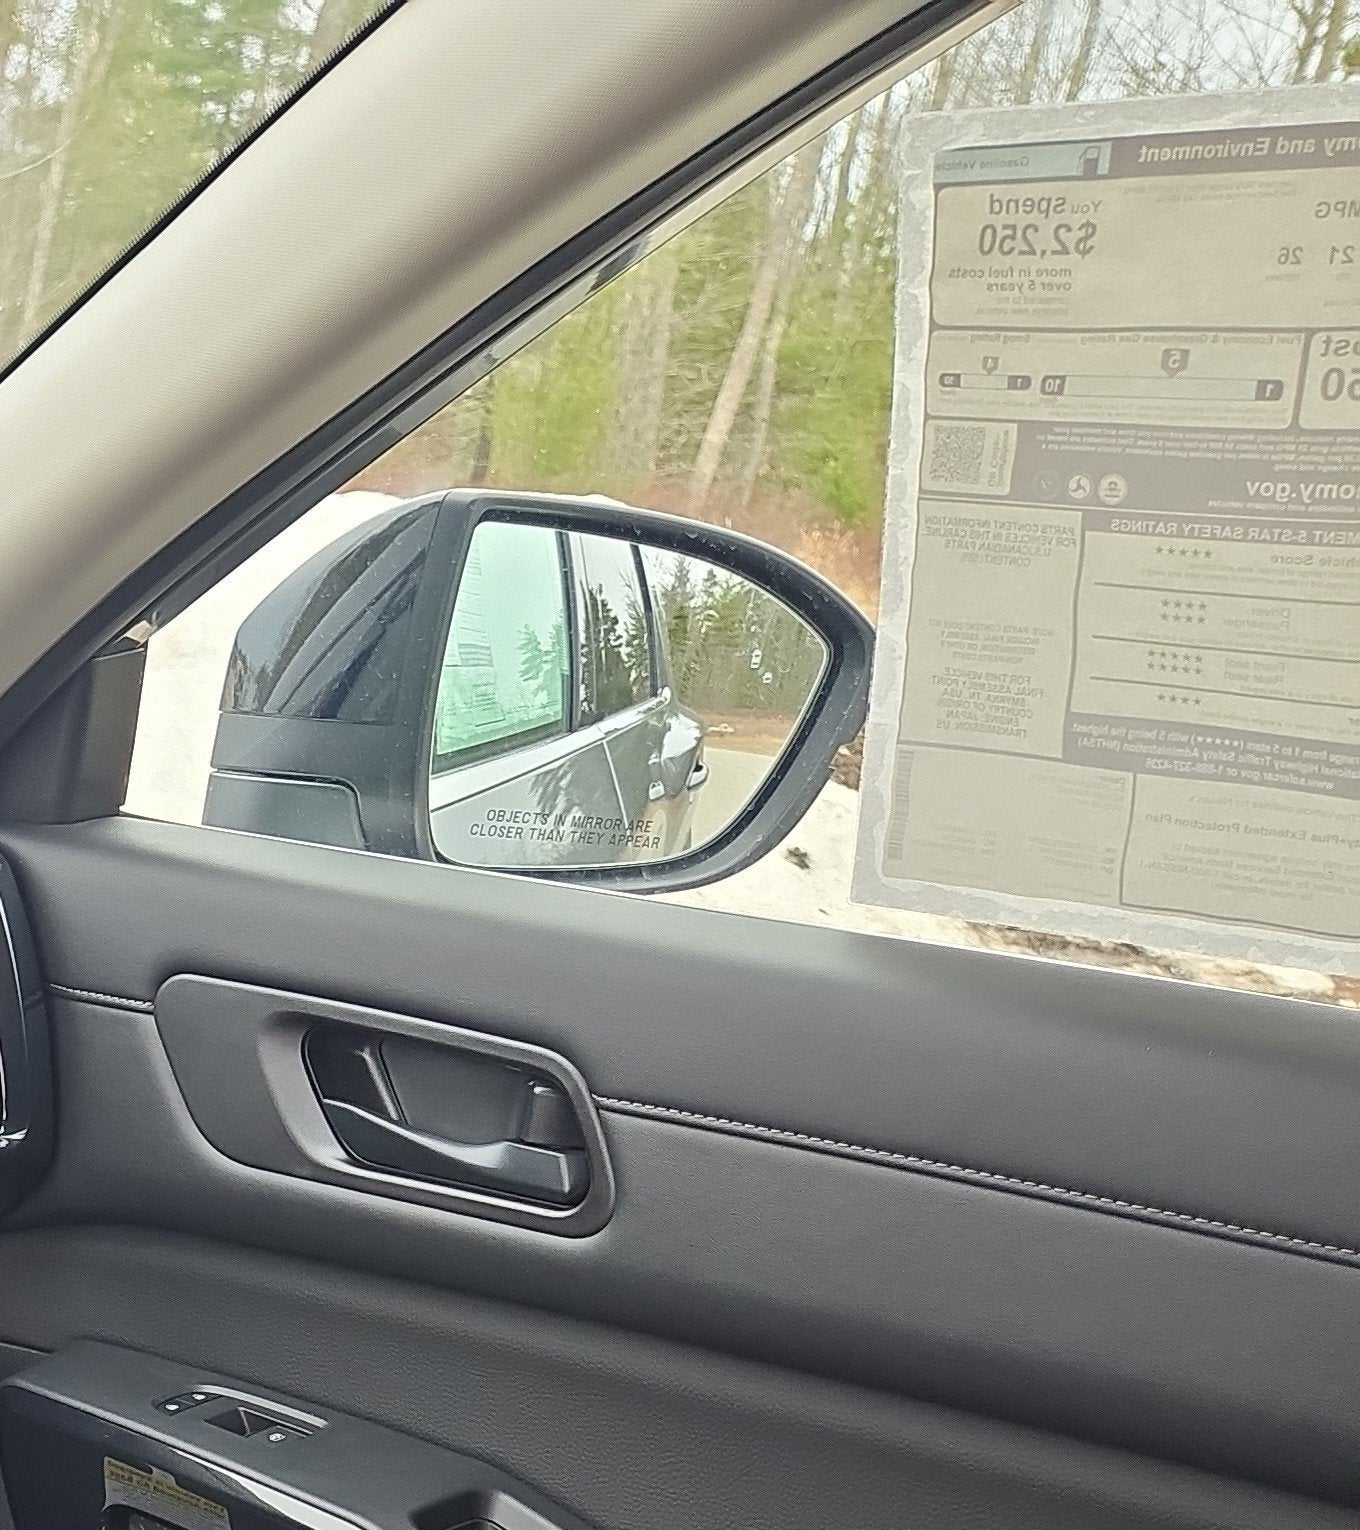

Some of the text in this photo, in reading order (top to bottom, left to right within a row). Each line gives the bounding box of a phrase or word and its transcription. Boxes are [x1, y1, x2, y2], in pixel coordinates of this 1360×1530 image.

[486, 809, 653, 833] OBJECTS IN MIRROR ARE
[470, 823, 660, 849] CLOSER THAN THEY APPEAR
